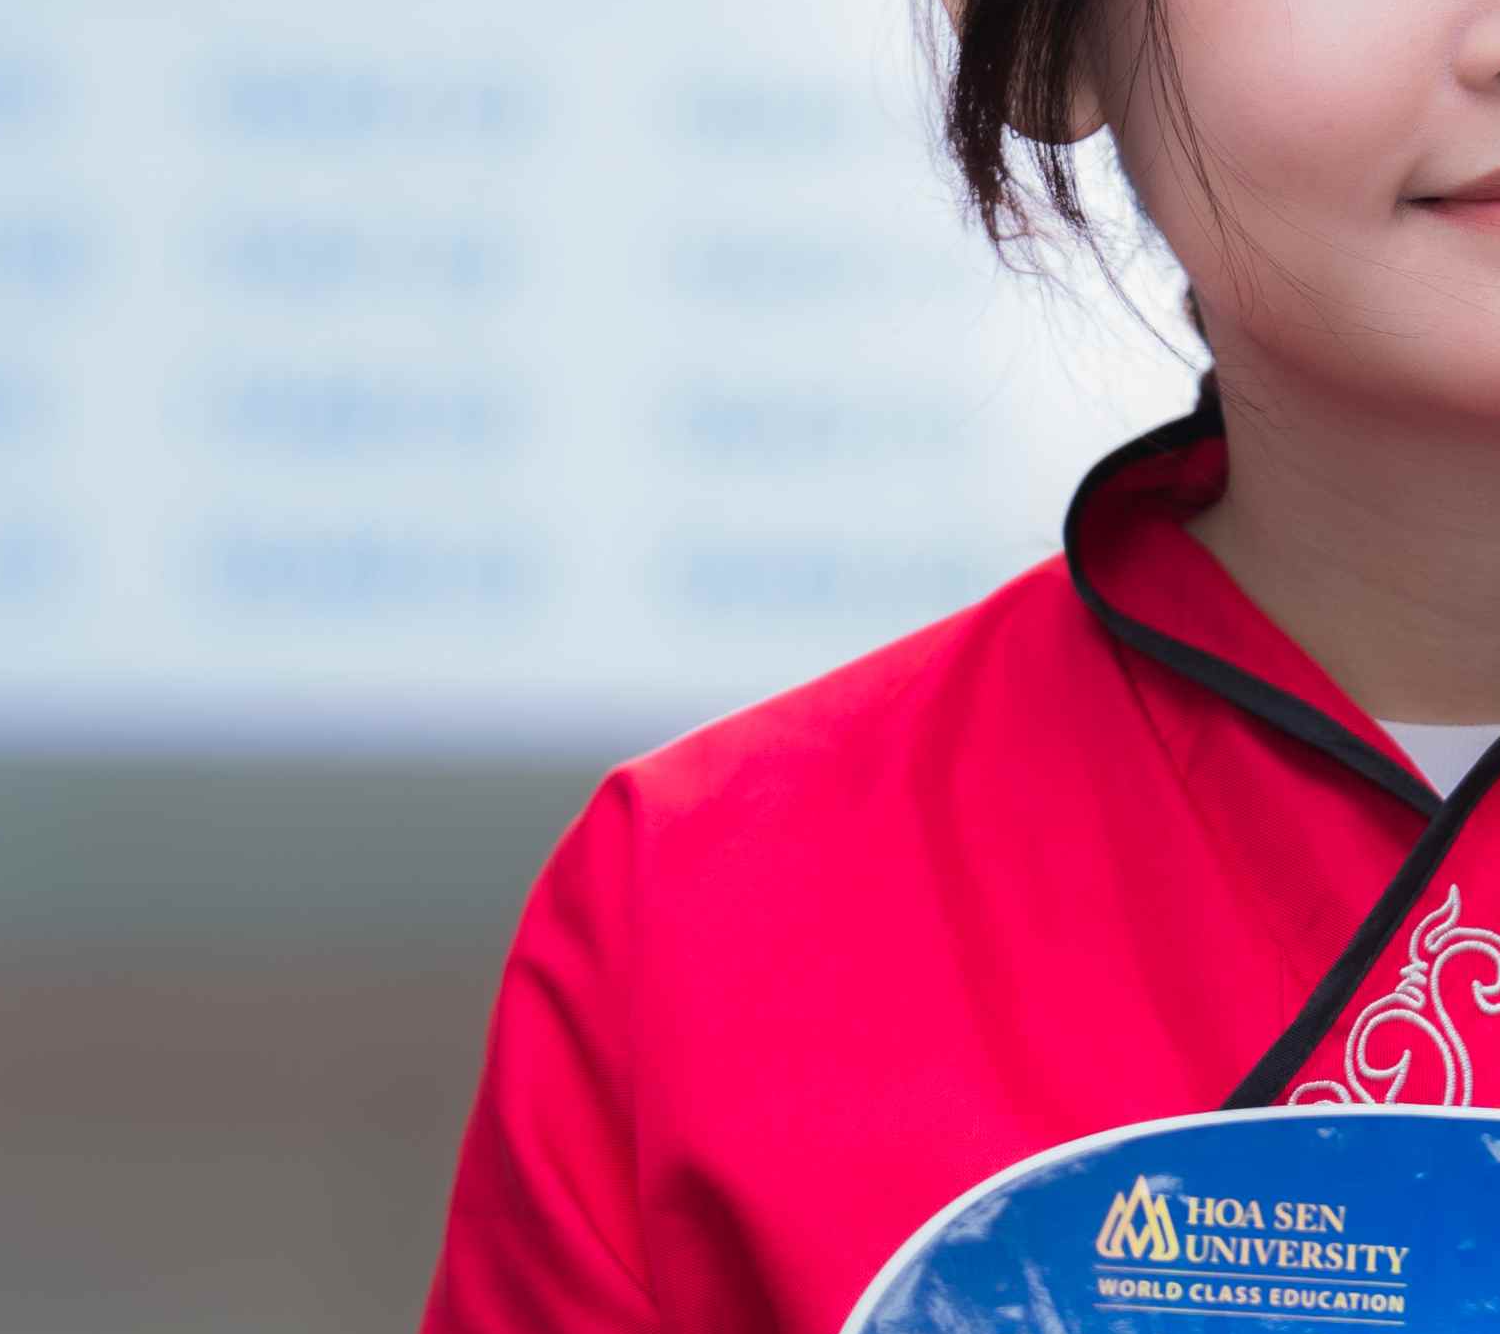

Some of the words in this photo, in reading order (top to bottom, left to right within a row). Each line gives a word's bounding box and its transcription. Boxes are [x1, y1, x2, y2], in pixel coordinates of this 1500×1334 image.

[1187, 1196, 1265, 1230] HOA
[1274, 1201, 1346, 1233] SEN
[1185, 1235, 1410, 1275] UNIVERSITY
[1099, 1278, 1183, 1301] WORLD
[1189, 1282, 1261, 1305] CLASS
[1269, 1288, 1405, 1313] EDUCATION
